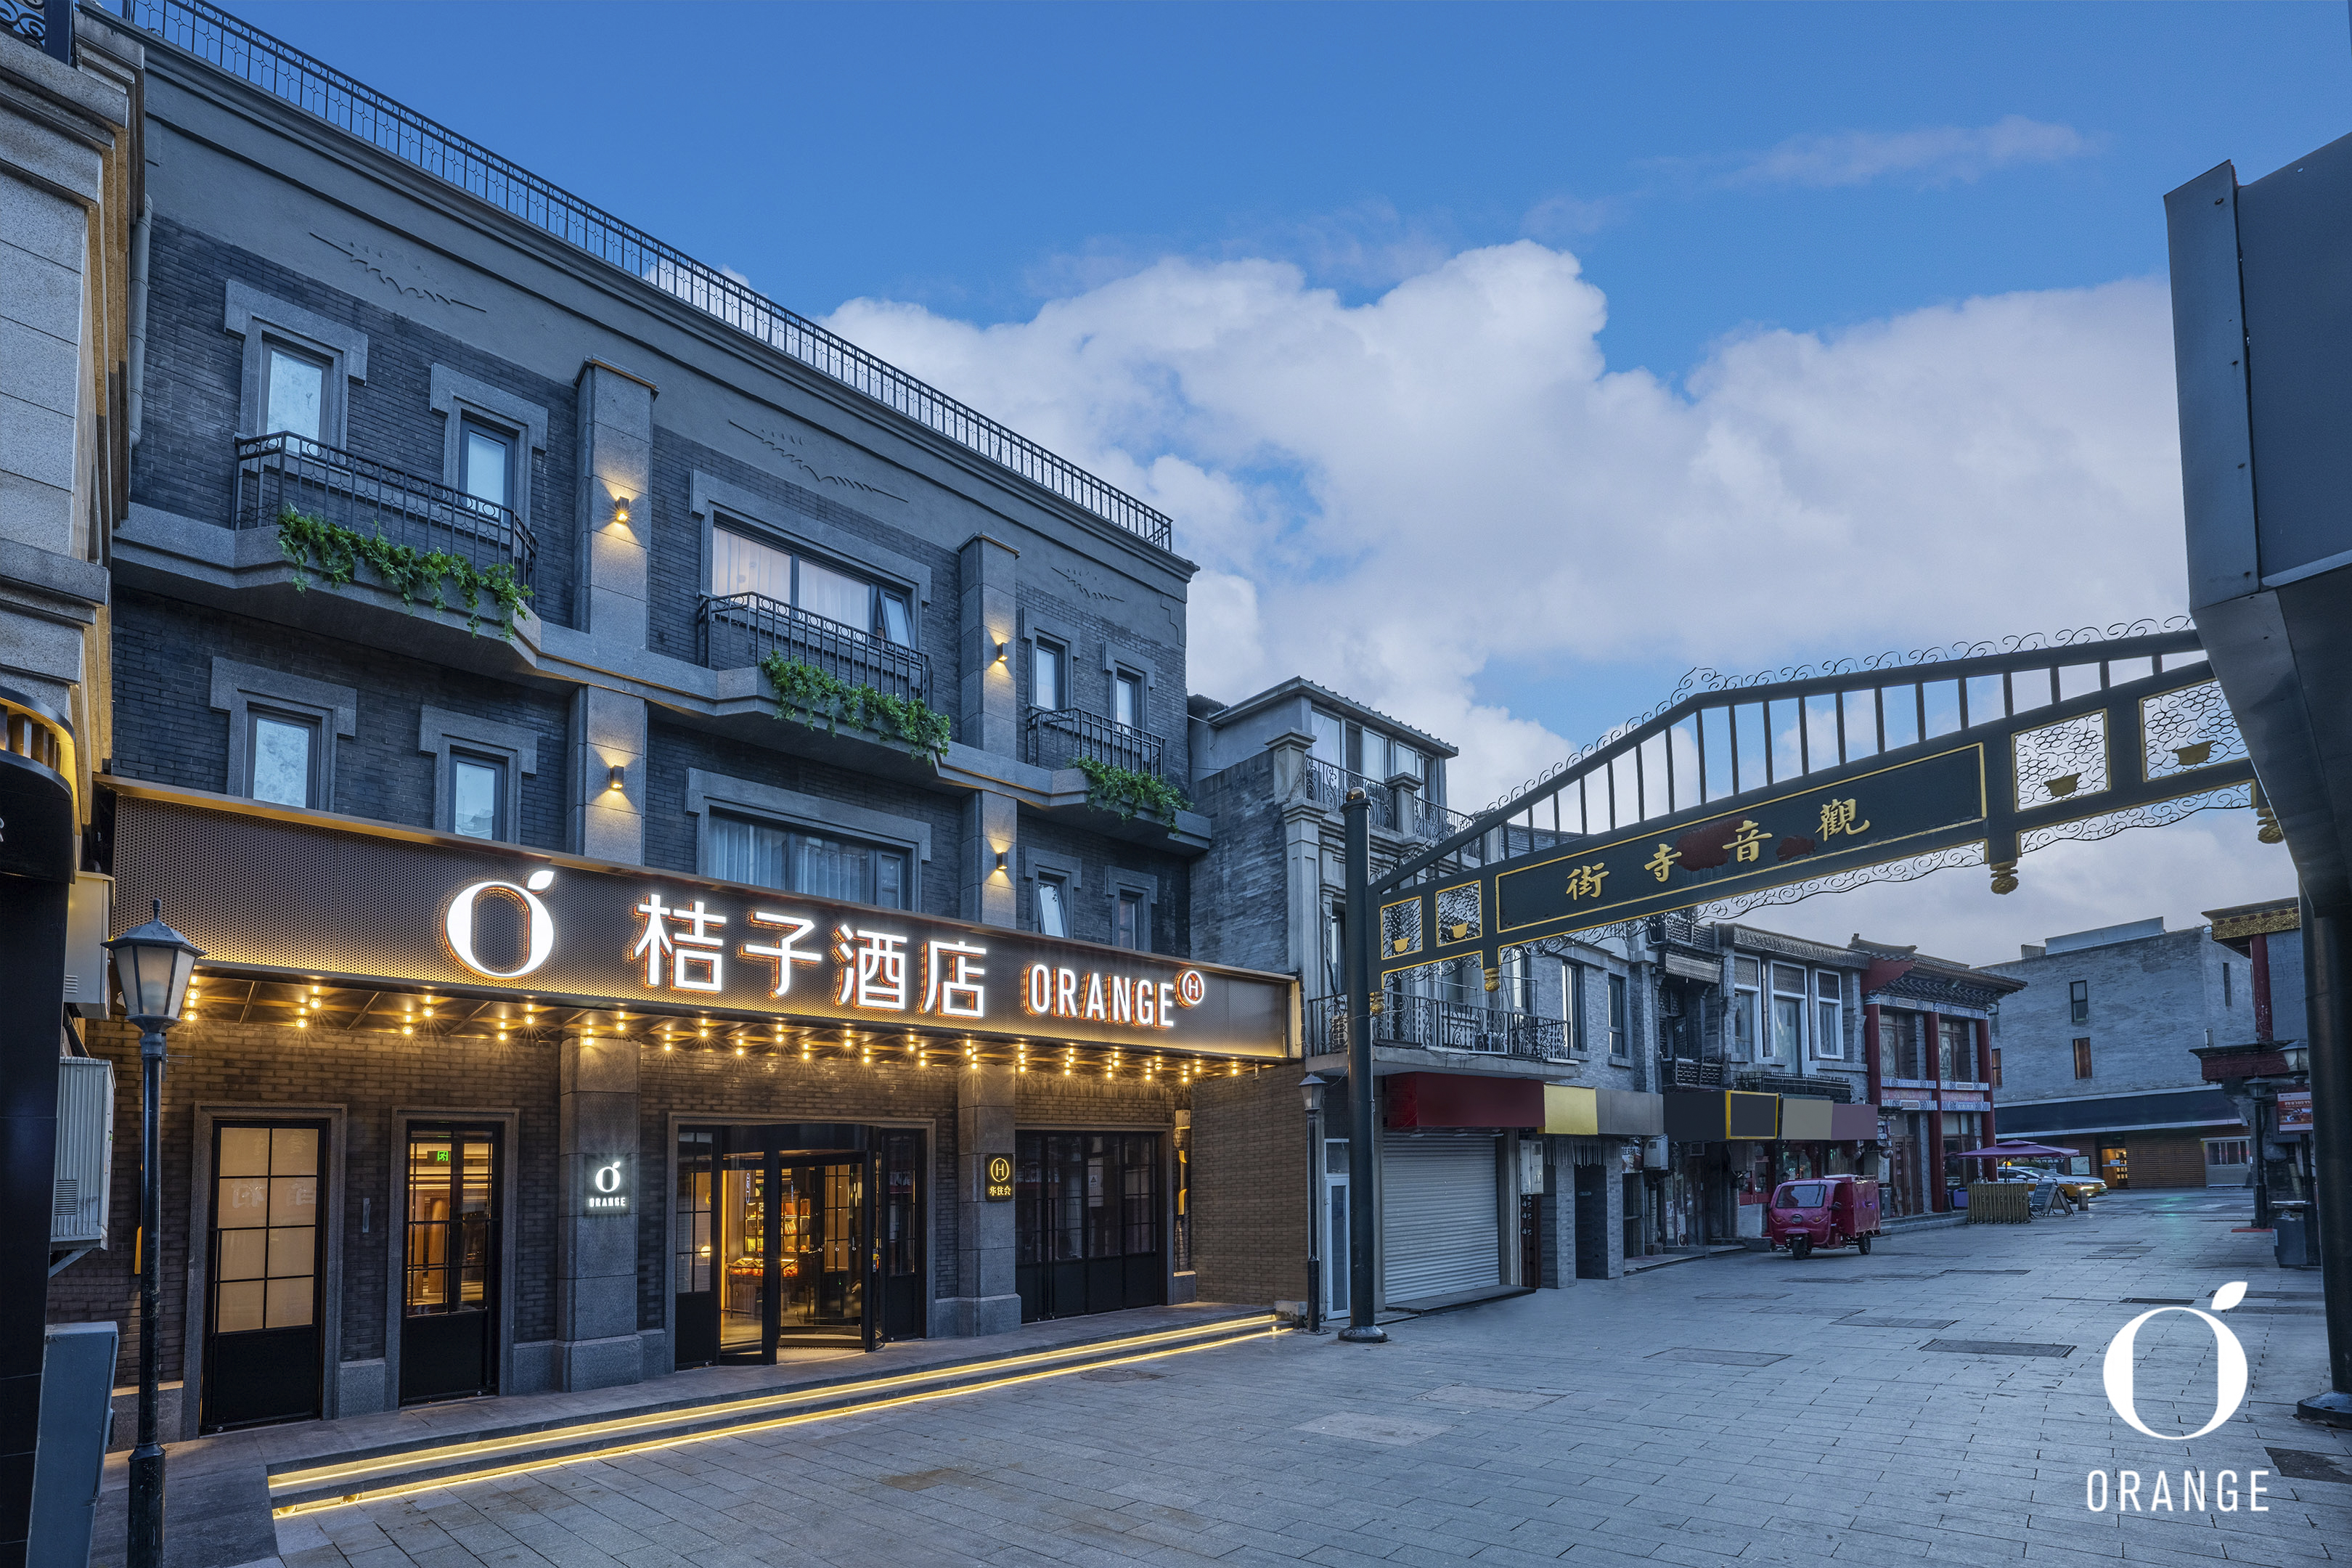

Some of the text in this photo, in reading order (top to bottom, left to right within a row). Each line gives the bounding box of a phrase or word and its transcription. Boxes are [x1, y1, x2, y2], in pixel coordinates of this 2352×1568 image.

[632, 894, 987, 1018] 桔子酒店
[1024, 963, 1175, 1028] ORANGE
[589, 1196, 626, 1208] ORANGE
[989, 1185, 1011, 1197] 华住会
